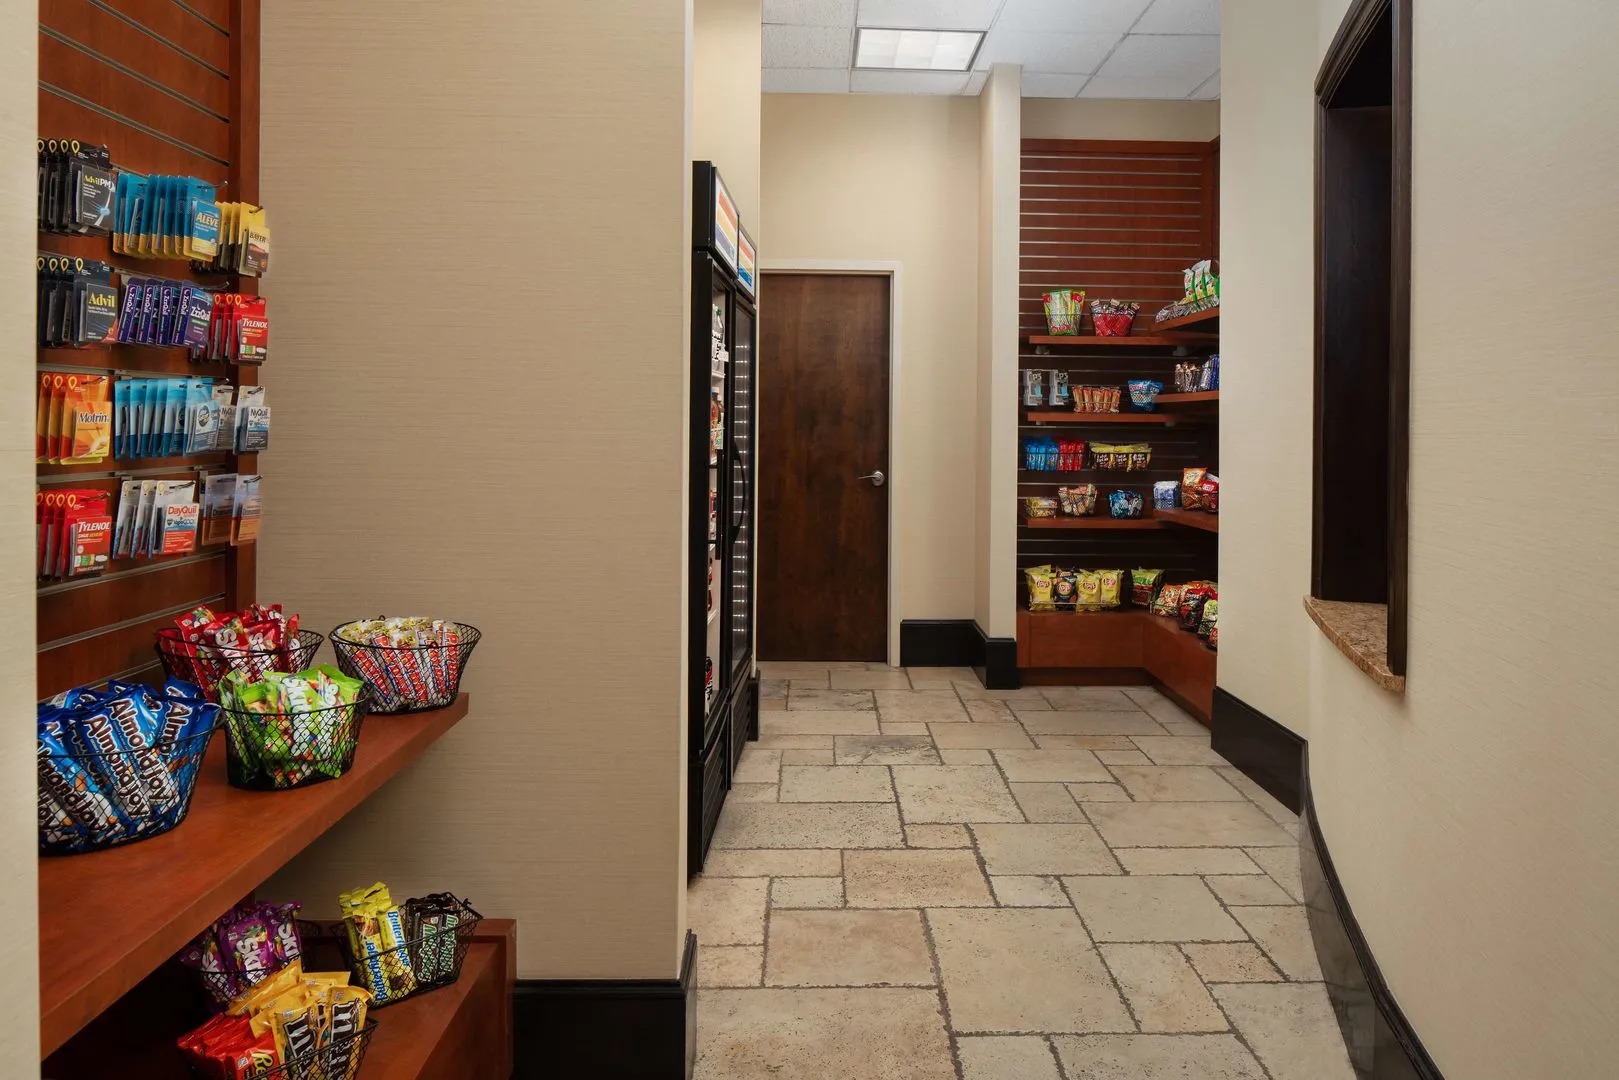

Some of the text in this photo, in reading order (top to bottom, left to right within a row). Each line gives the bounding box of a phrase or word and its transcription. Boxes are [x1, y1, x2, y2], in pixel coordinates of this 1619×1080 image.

[84, 175, 100, 185] Advil
[197, 212, 219, 228] ALEVE
[88, 291, 115, 308] Advil
[242, 317, 268, 329] TYLENOL
[80, 412, 107, 423] Motrin
[250, 408, 268, 418] NyQuil
[167, 505, 197, 516] DayQuil
[78, 521, 111, 533] TYLENOL
[365, 939, 388, 1001] Butterfinger
